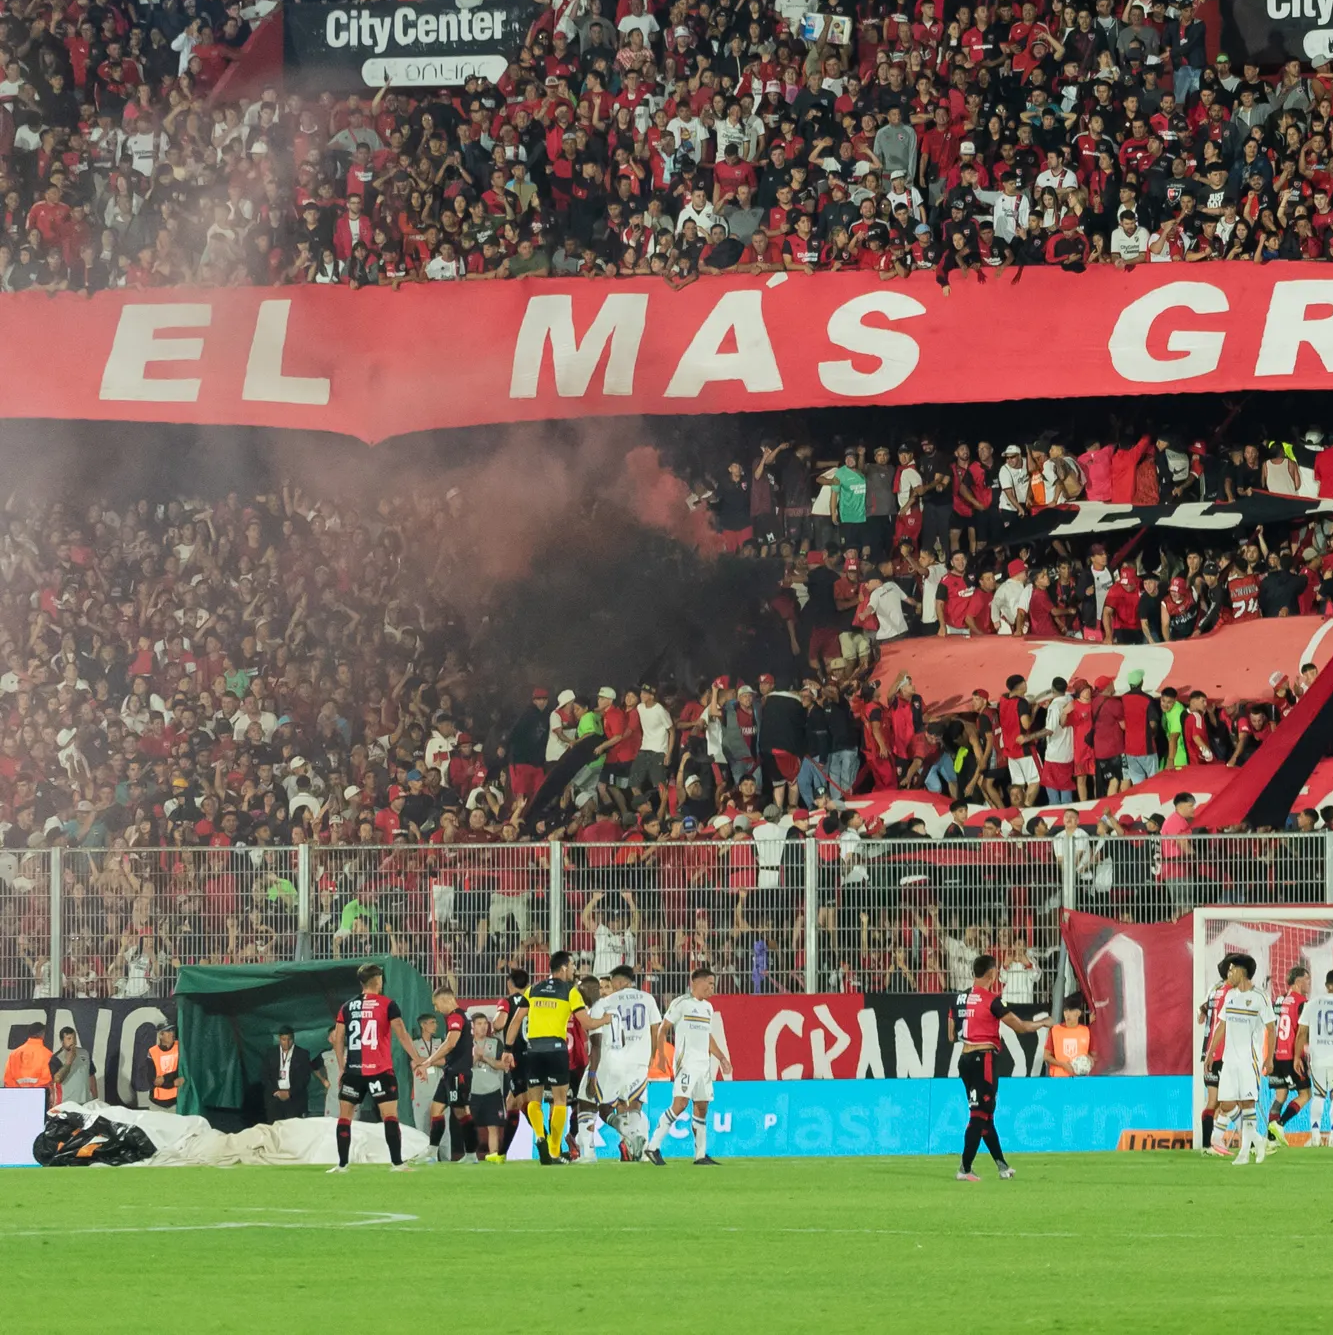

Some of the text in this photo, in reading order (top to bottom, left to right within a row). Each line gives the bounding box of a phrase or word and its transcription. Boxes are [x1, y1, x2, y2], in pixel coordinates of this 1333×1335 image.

[326, 7, 506, 54] CityCenter
[99, 298, 330, 406] EL
[509, 271, 927, 400] MÁS
[617, 1003, 646, 1031] 40
[348, 1019, 378, 1051] 24
[681, 1073, 690, 1086] 21
[449, 1090, 458, 1102] 19
